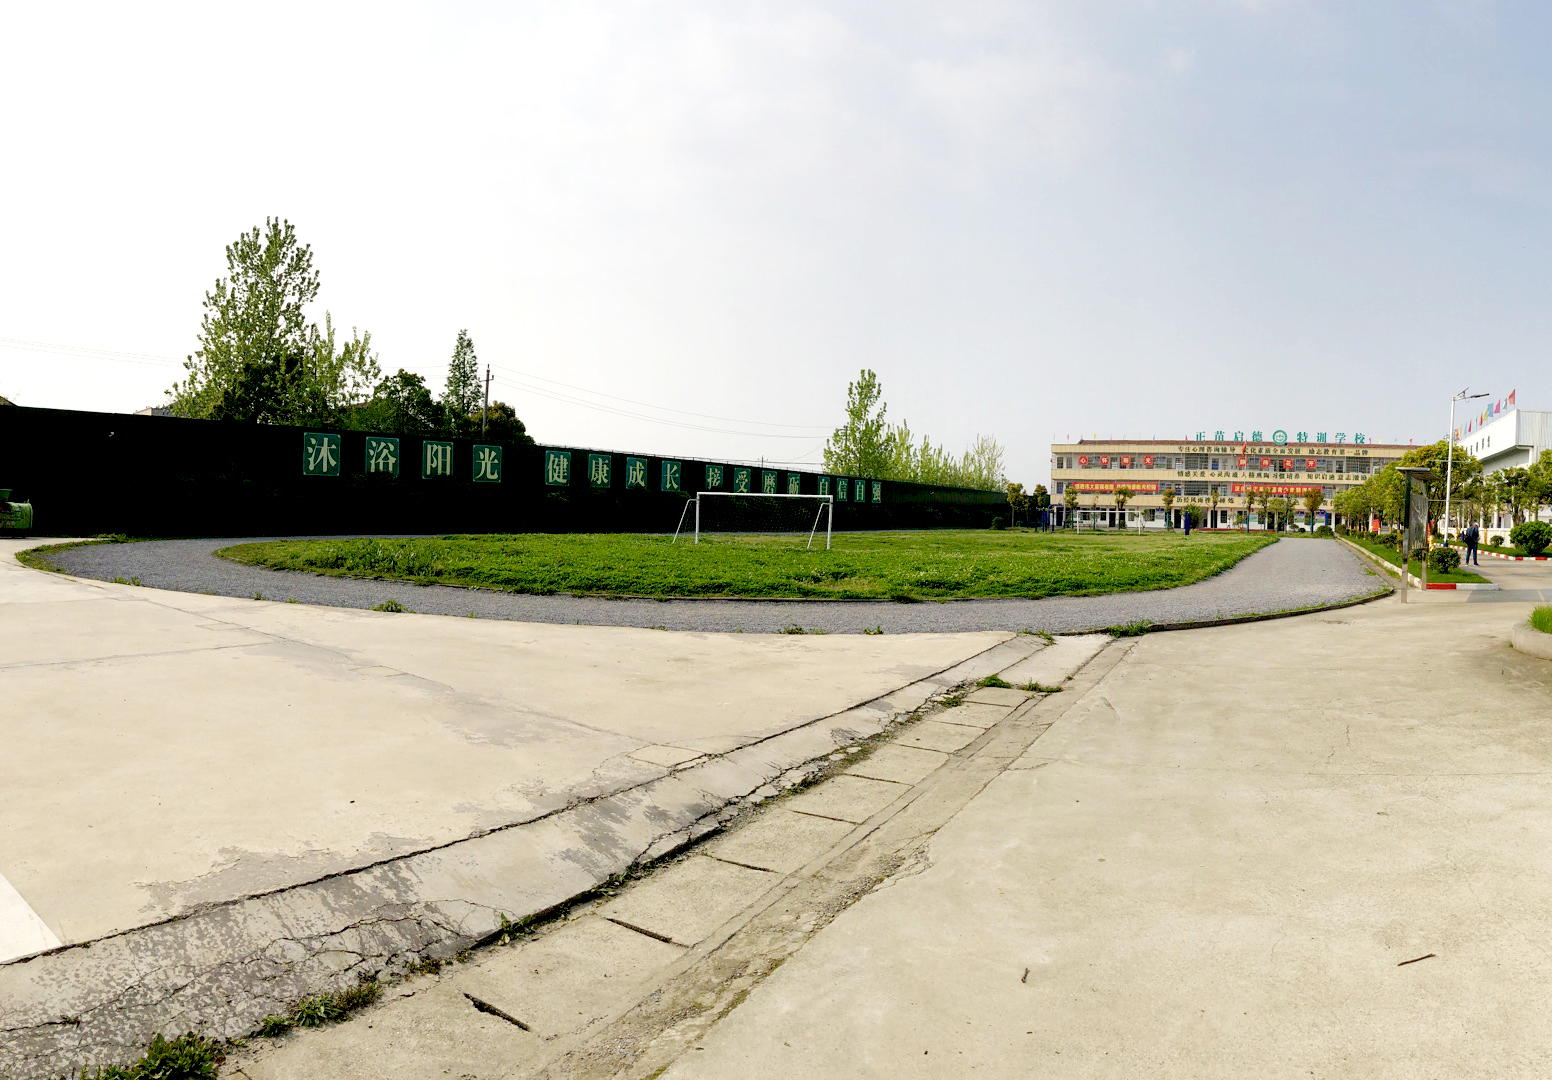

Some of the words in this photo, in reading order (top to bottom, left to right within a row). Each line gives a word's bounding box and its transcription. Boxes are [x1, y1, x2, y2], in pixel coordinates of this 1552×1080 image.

[1195, 431, 1263, 443] 正苗启德
[1296, 431, 1366, 444] 特训学校
[307, 437, 499, 479] 沐浴阳光
[547, 453, 679, 489] 健康成长
[707, 467, 799, 495] 接受磨砺
[819, 478, 881, 501] 自信自强
